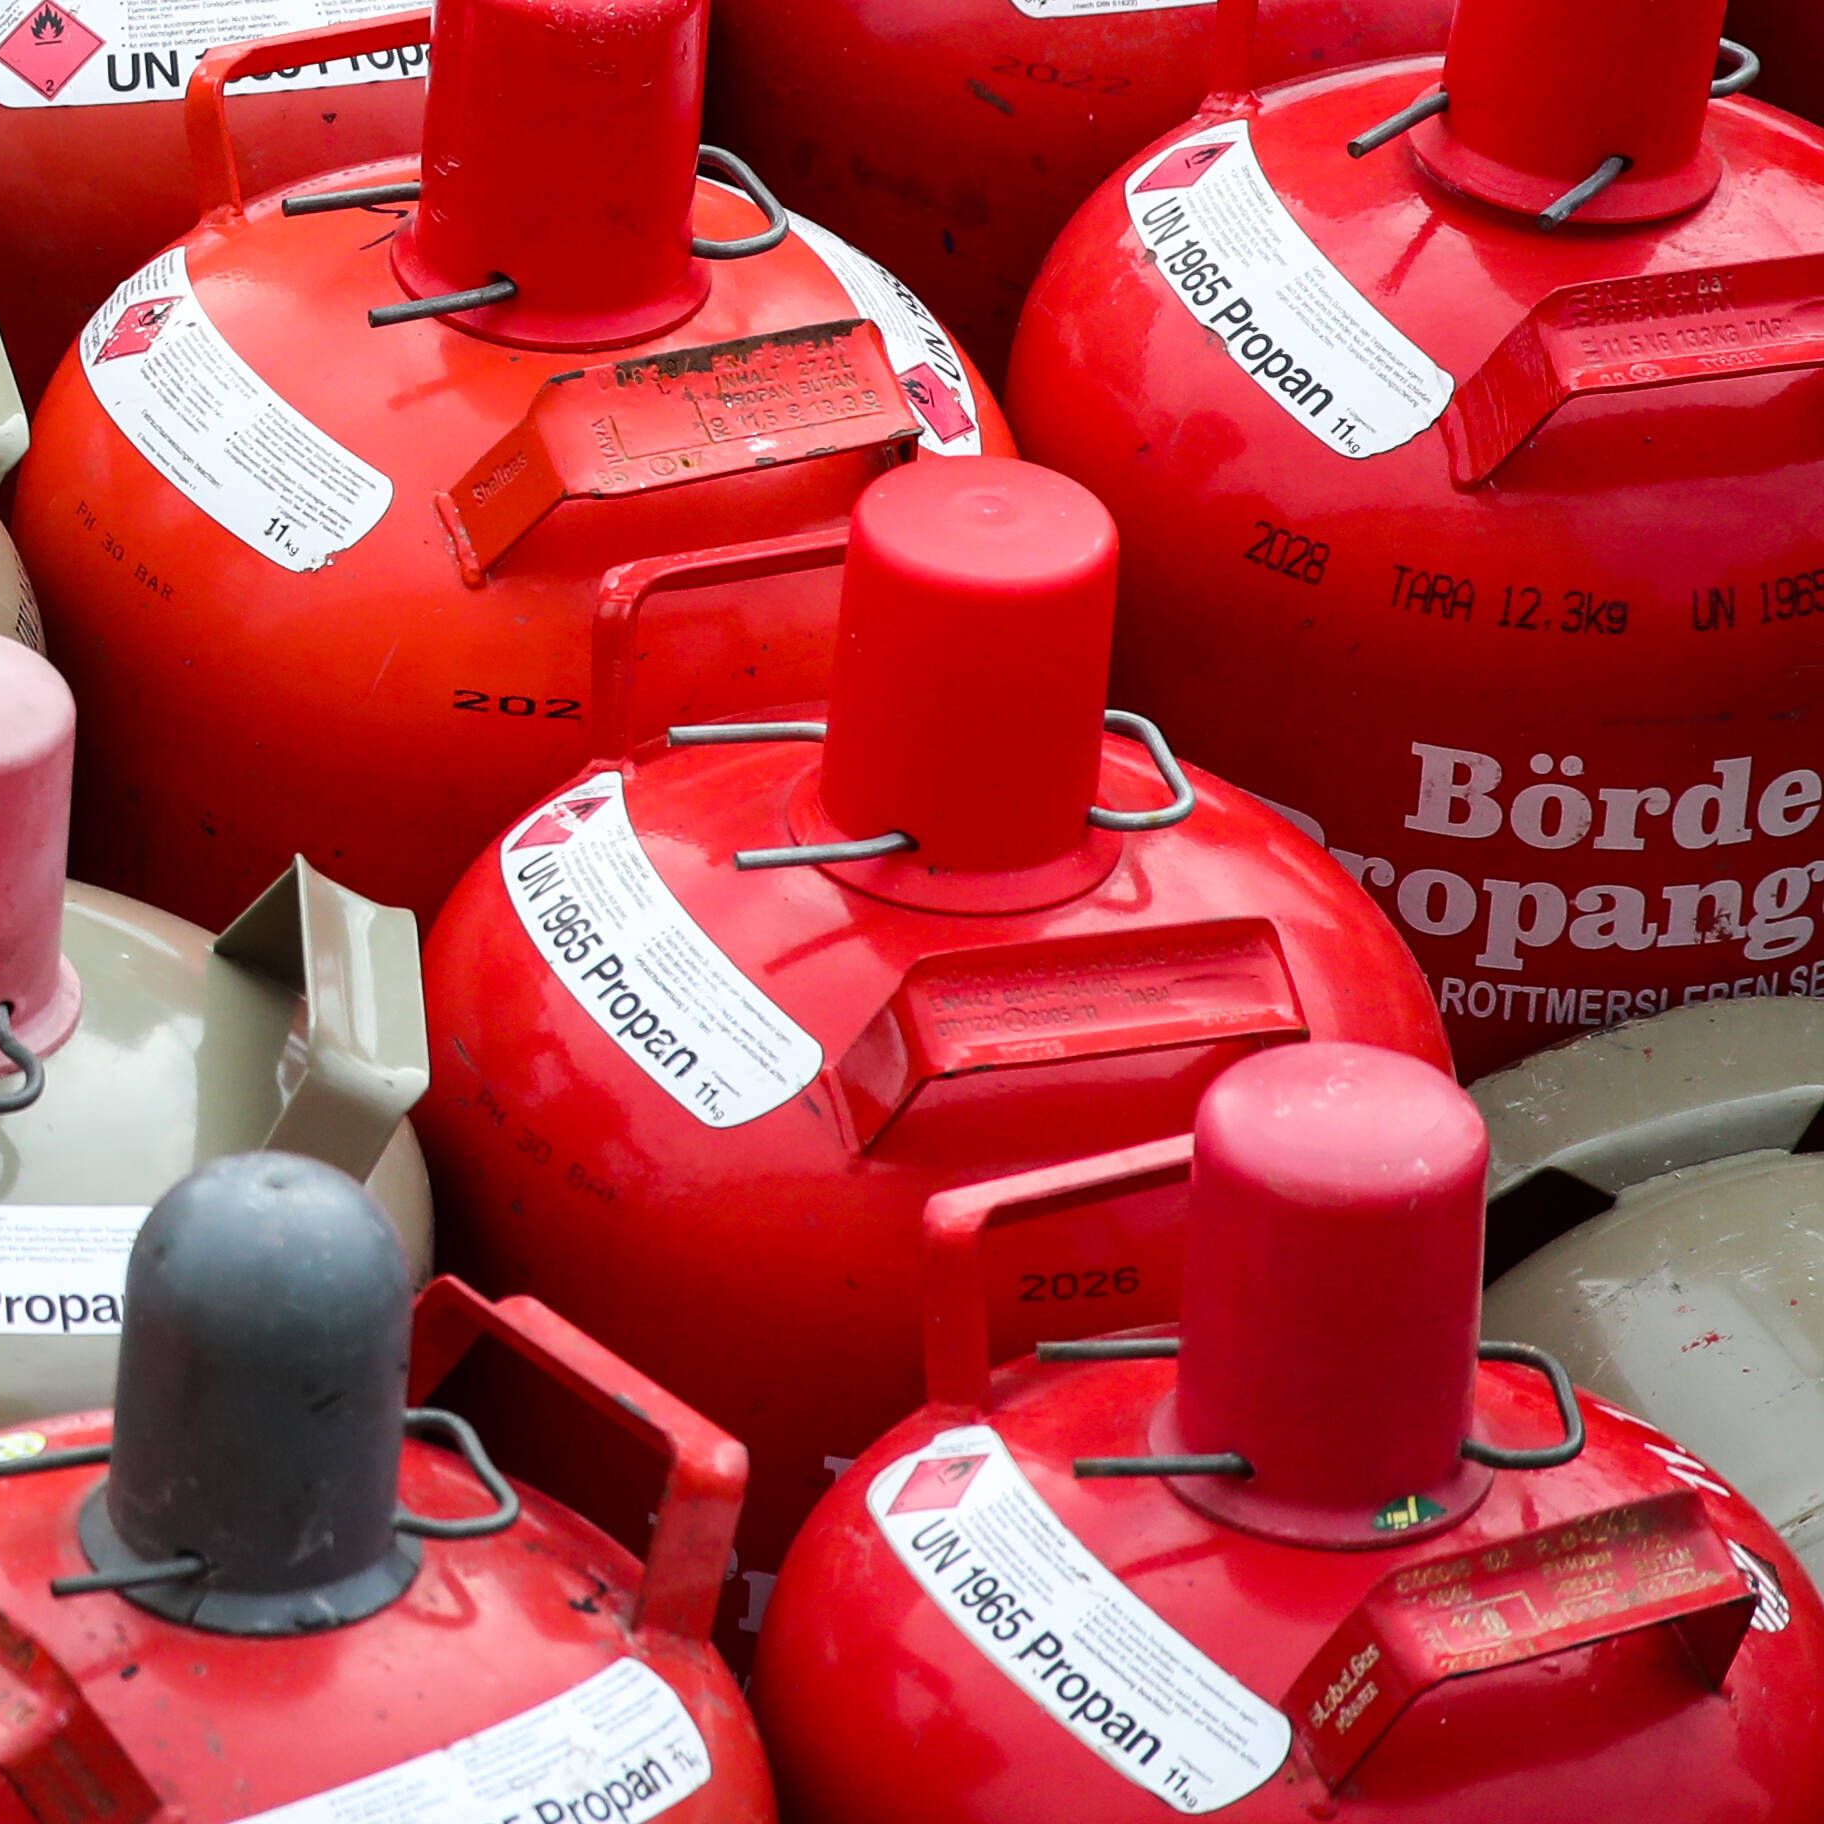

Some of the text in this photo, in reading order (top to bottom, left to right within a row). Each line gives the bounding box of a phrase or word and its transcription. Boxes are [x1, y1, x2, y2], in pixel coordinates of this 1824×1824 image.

[106, 49, 181, 94] UN
[1143, 195, 1182, 247] UN
[1163, 235, 1231, 309] 1965
[1209, 293, 1334, 418] Propan
[917, 326, 962, 383] UN
[72, 499, 176, 599] PH 30 BAR
[1243, 520, 1824, 635] 2028 TARA 12.3kg UN 1965
[452, 688, 583, 722] 202
[1403, 740, 1824, 851] Börde
[517, 849, 559, 904] UN
[534, 891, 601, 966] 1965
[581, 948, 699, 1079] Propan
[1018, 1265, 1141, 1305] 2026
[910, 1518, 972, 1577] UN
[950, 1560, 1026, 1642] 1965
[1018, 1629, 1162, 1768] Propan
